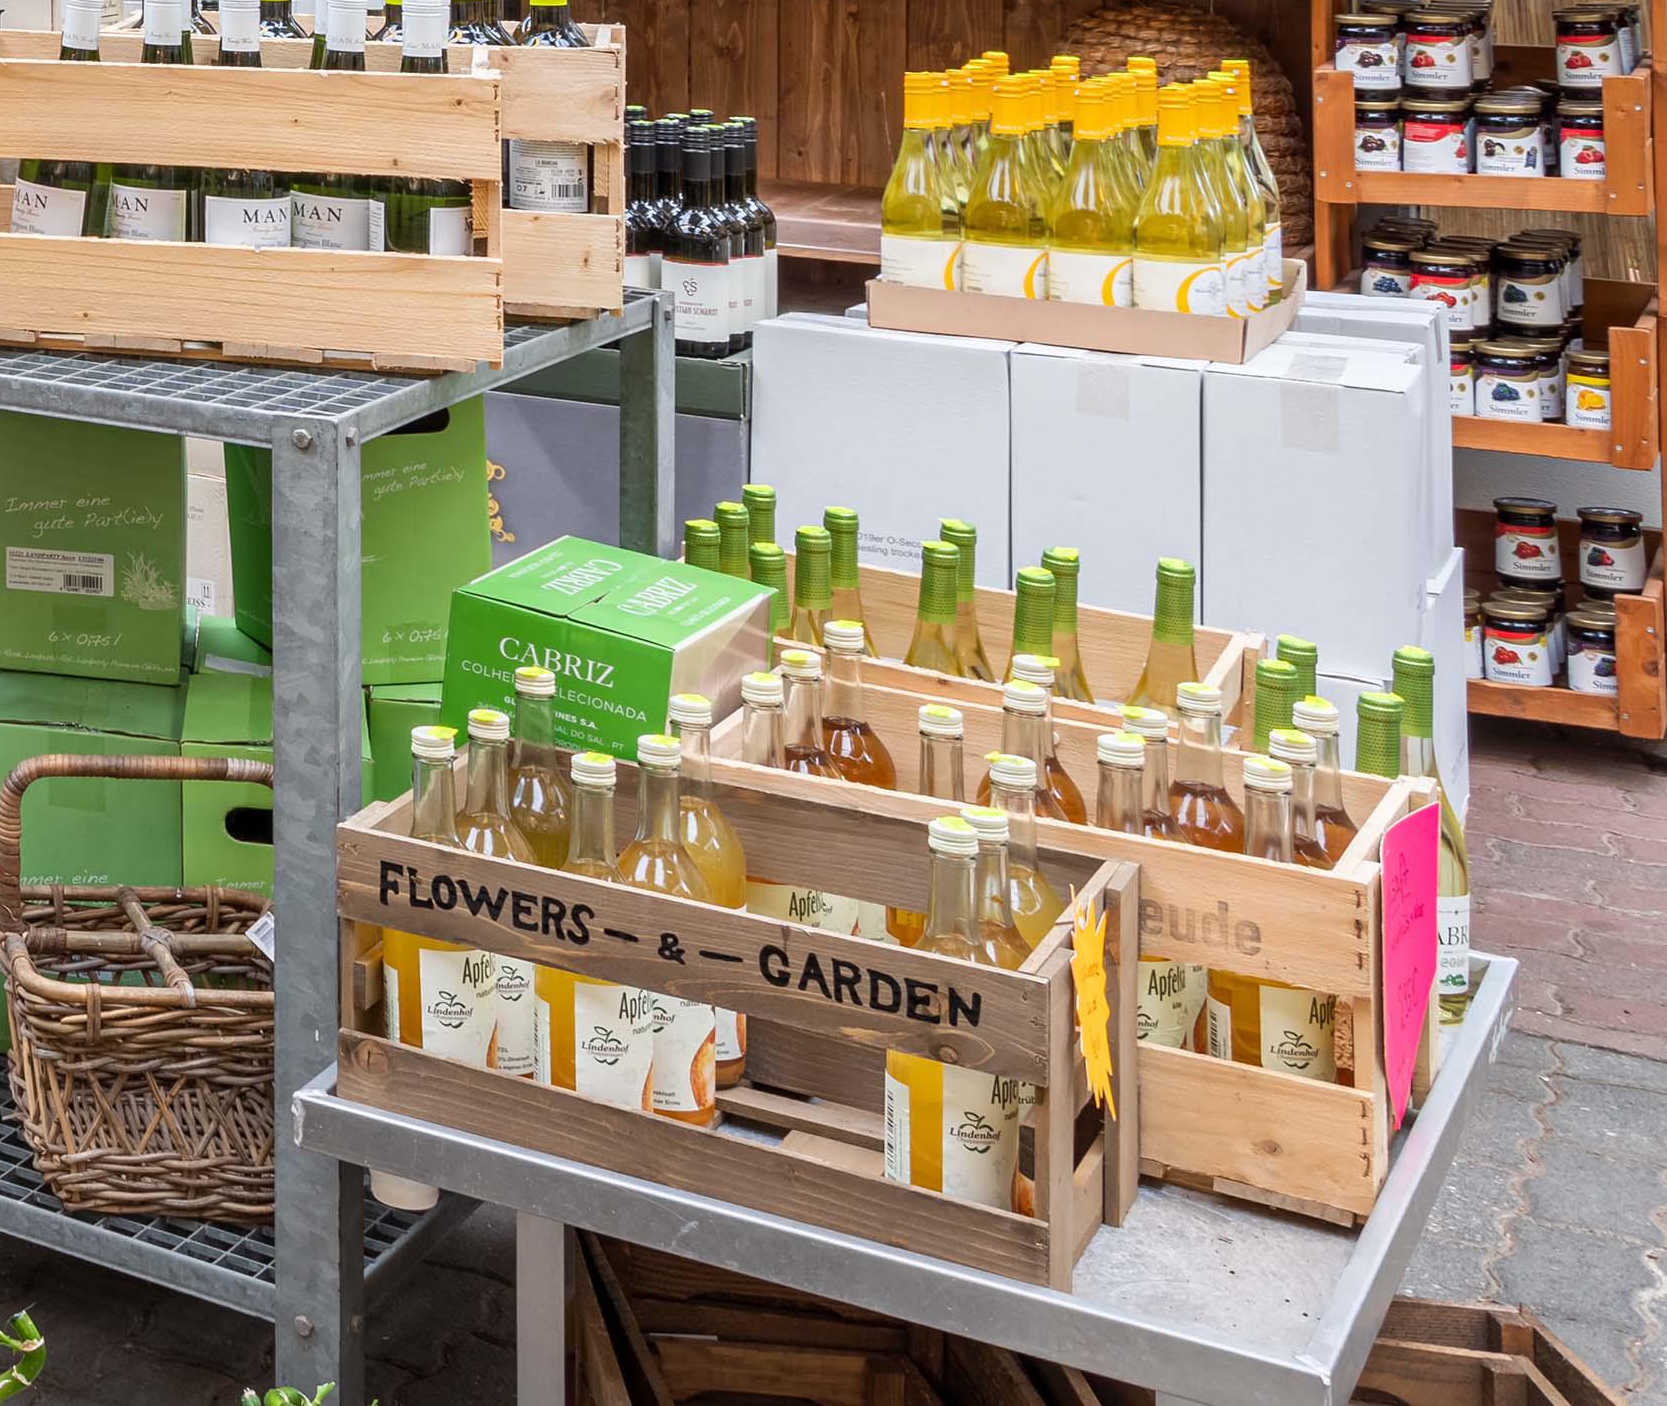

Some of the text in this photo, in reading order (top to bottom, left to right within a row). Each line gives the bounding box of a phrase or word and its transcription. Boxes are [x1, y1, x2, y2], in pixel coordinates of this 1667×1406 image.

[1564, 70, 1603, 82] Simmler
[1488, 404, 1529, 417] Simmler
[5, 492, 111, 513] Immer eine
[32, 515, 74, 538] gute
[617, 577, 697, 617] CABRIZ
[48, 631, 58, 642] 6
[498, 637, 615, 689] CABRIZ
[1492, 668, 1533, 681] Simmler
[461, 660, 647, 723] COLHEI ELECIONADA
[1140, 898, 1261, 959] eude
[378, 860, 982, 1029] FLOWERS & GARDEN
[426, 1002, 474, 1022] Lindenhof
[581, 1038, 630, 1059] Lindenhof
[1269, 1044, 1320, 1062] Lindenhof
